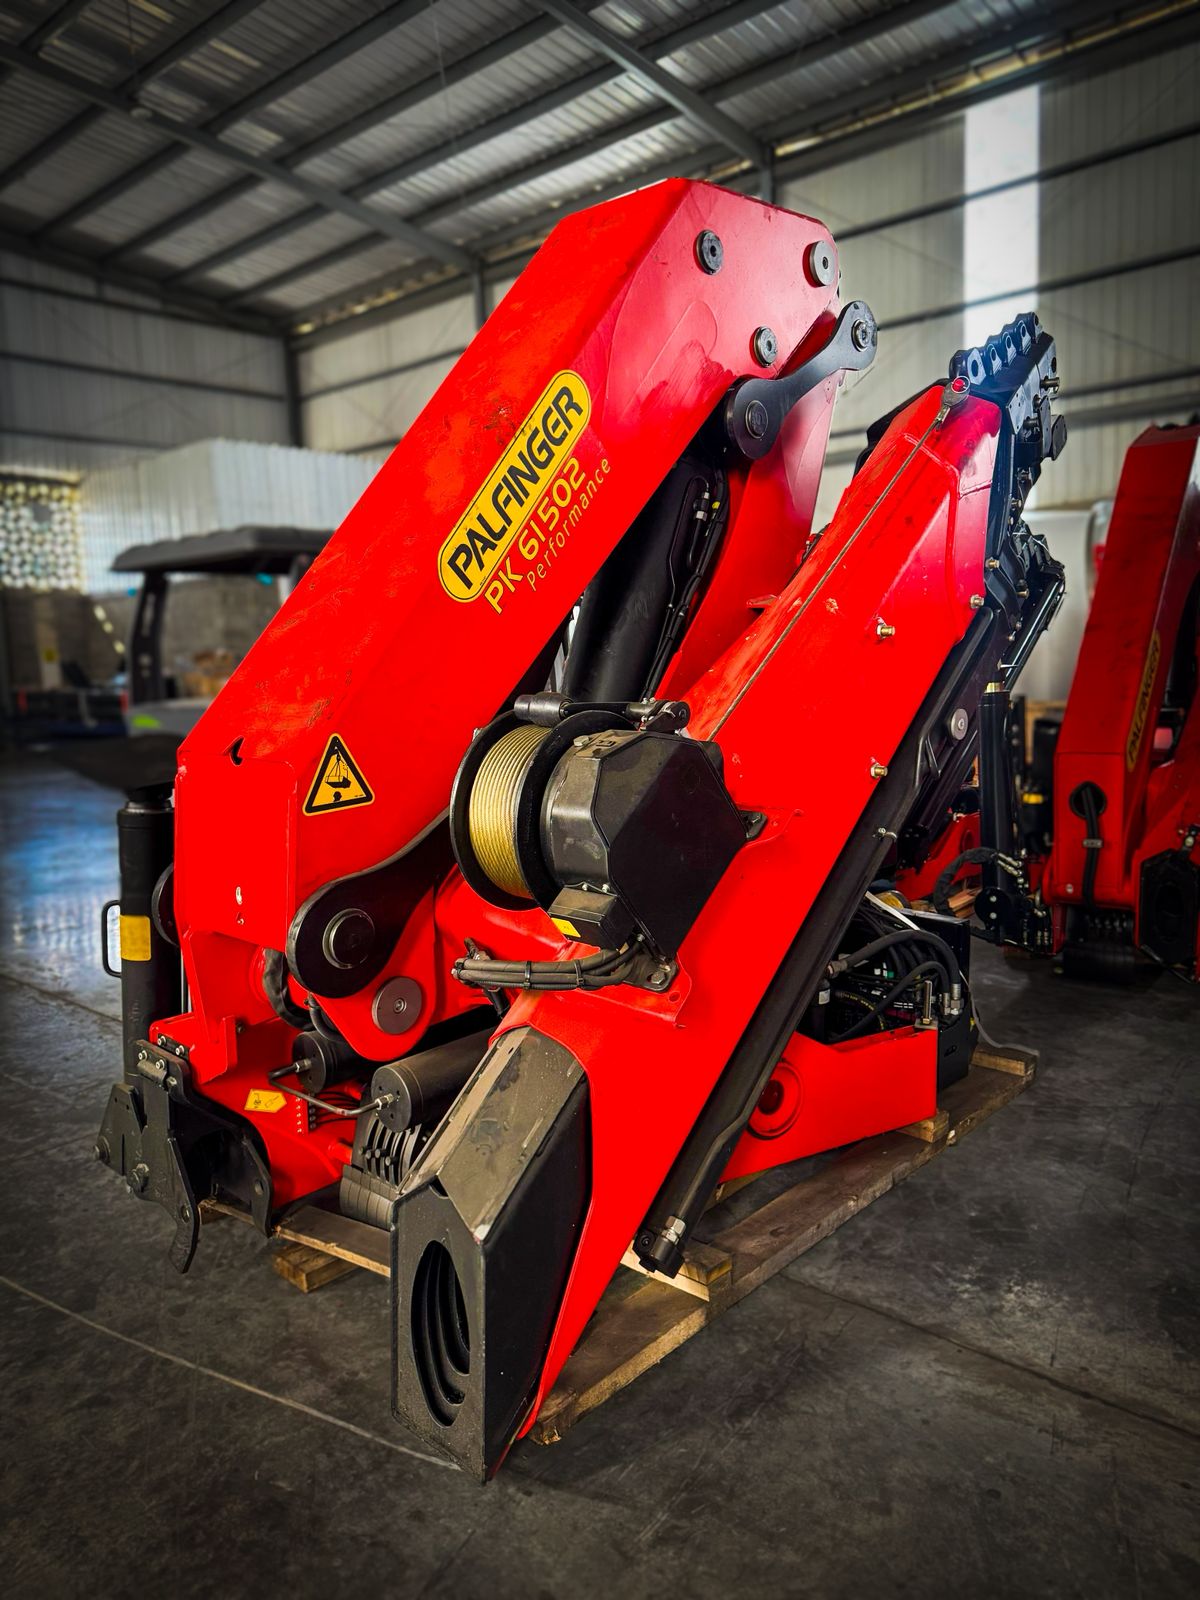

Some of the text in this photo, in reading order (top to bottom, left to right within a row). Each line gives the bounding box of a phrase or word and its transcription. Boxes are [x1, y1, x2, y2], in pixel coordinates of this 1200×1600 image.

[447, 386, 583, 590] PALFINGER
[484, 457, 586, 614] PK 61502
[527, 458, 611, 591] Performance
